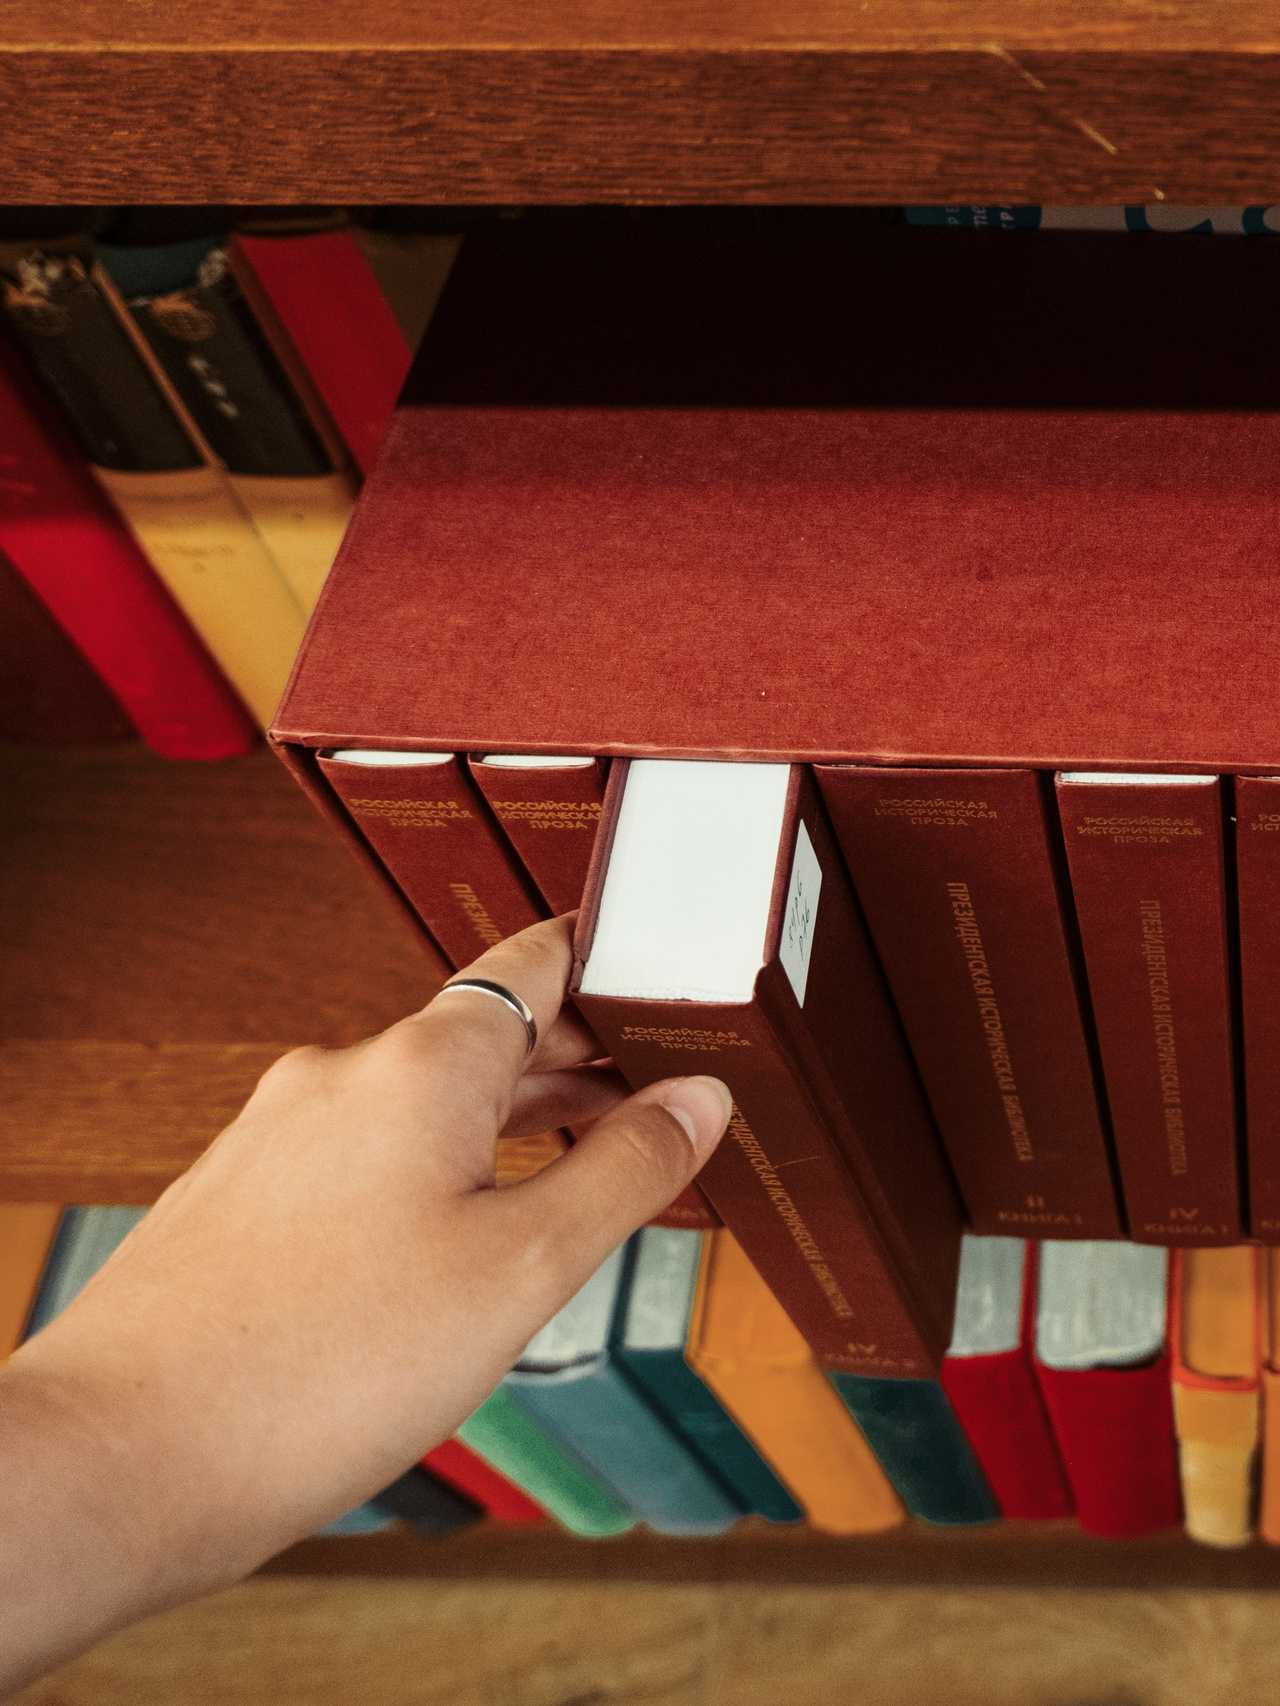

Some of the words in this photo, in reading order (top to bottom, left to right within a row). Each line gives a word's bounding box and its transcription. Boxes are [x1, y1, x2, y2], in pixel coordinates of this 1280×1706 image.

[350, 799, 459, 809] РОССИЙСКАЯ
[880, 799, 988, 809] РОССИЙСКАЯ
[351, 807, 473, 818] ИСТОРИЧЕСКАЯ
[874, 808, 998, 818] ИСТОРИЧЕСКАЯ
[389, 818, 447, 827] ПРОЗА
[530, 820, 588, 829] ПРОЗА
[911, 817, 968, 826] ПРОЗА
[1084, 816, 1194, 826] РОССИЙСКАЯ
[1077, 826, 1202, 835] ИСТОРИЧЕСКАЯ
[1113, 835, 1170, 843] ПРОЗА
[1140, 900, 1171, 1011] ПРЕЗИДЕНТСКАЯ
[947, 882, 994, 995] ПРЕЗИДЕНТСКАЯ
[978, 998, 1017, 1091] ИСТОРИЧЕСКАЯ
[623, 1026, 738, 1038] РОССИЙСКАЯ
[620, 1034, 751, 1046] ИСТОРИЧЕСКАЯ
[660, 1042, 721, 1051] ПРОЗА
[1154, 1014, 1180, 1103] ИСТОРИЧЕСКАЯ
[1170, 1207, 1200, 1219] IV
[847, 1342, 877, 1354] IV
